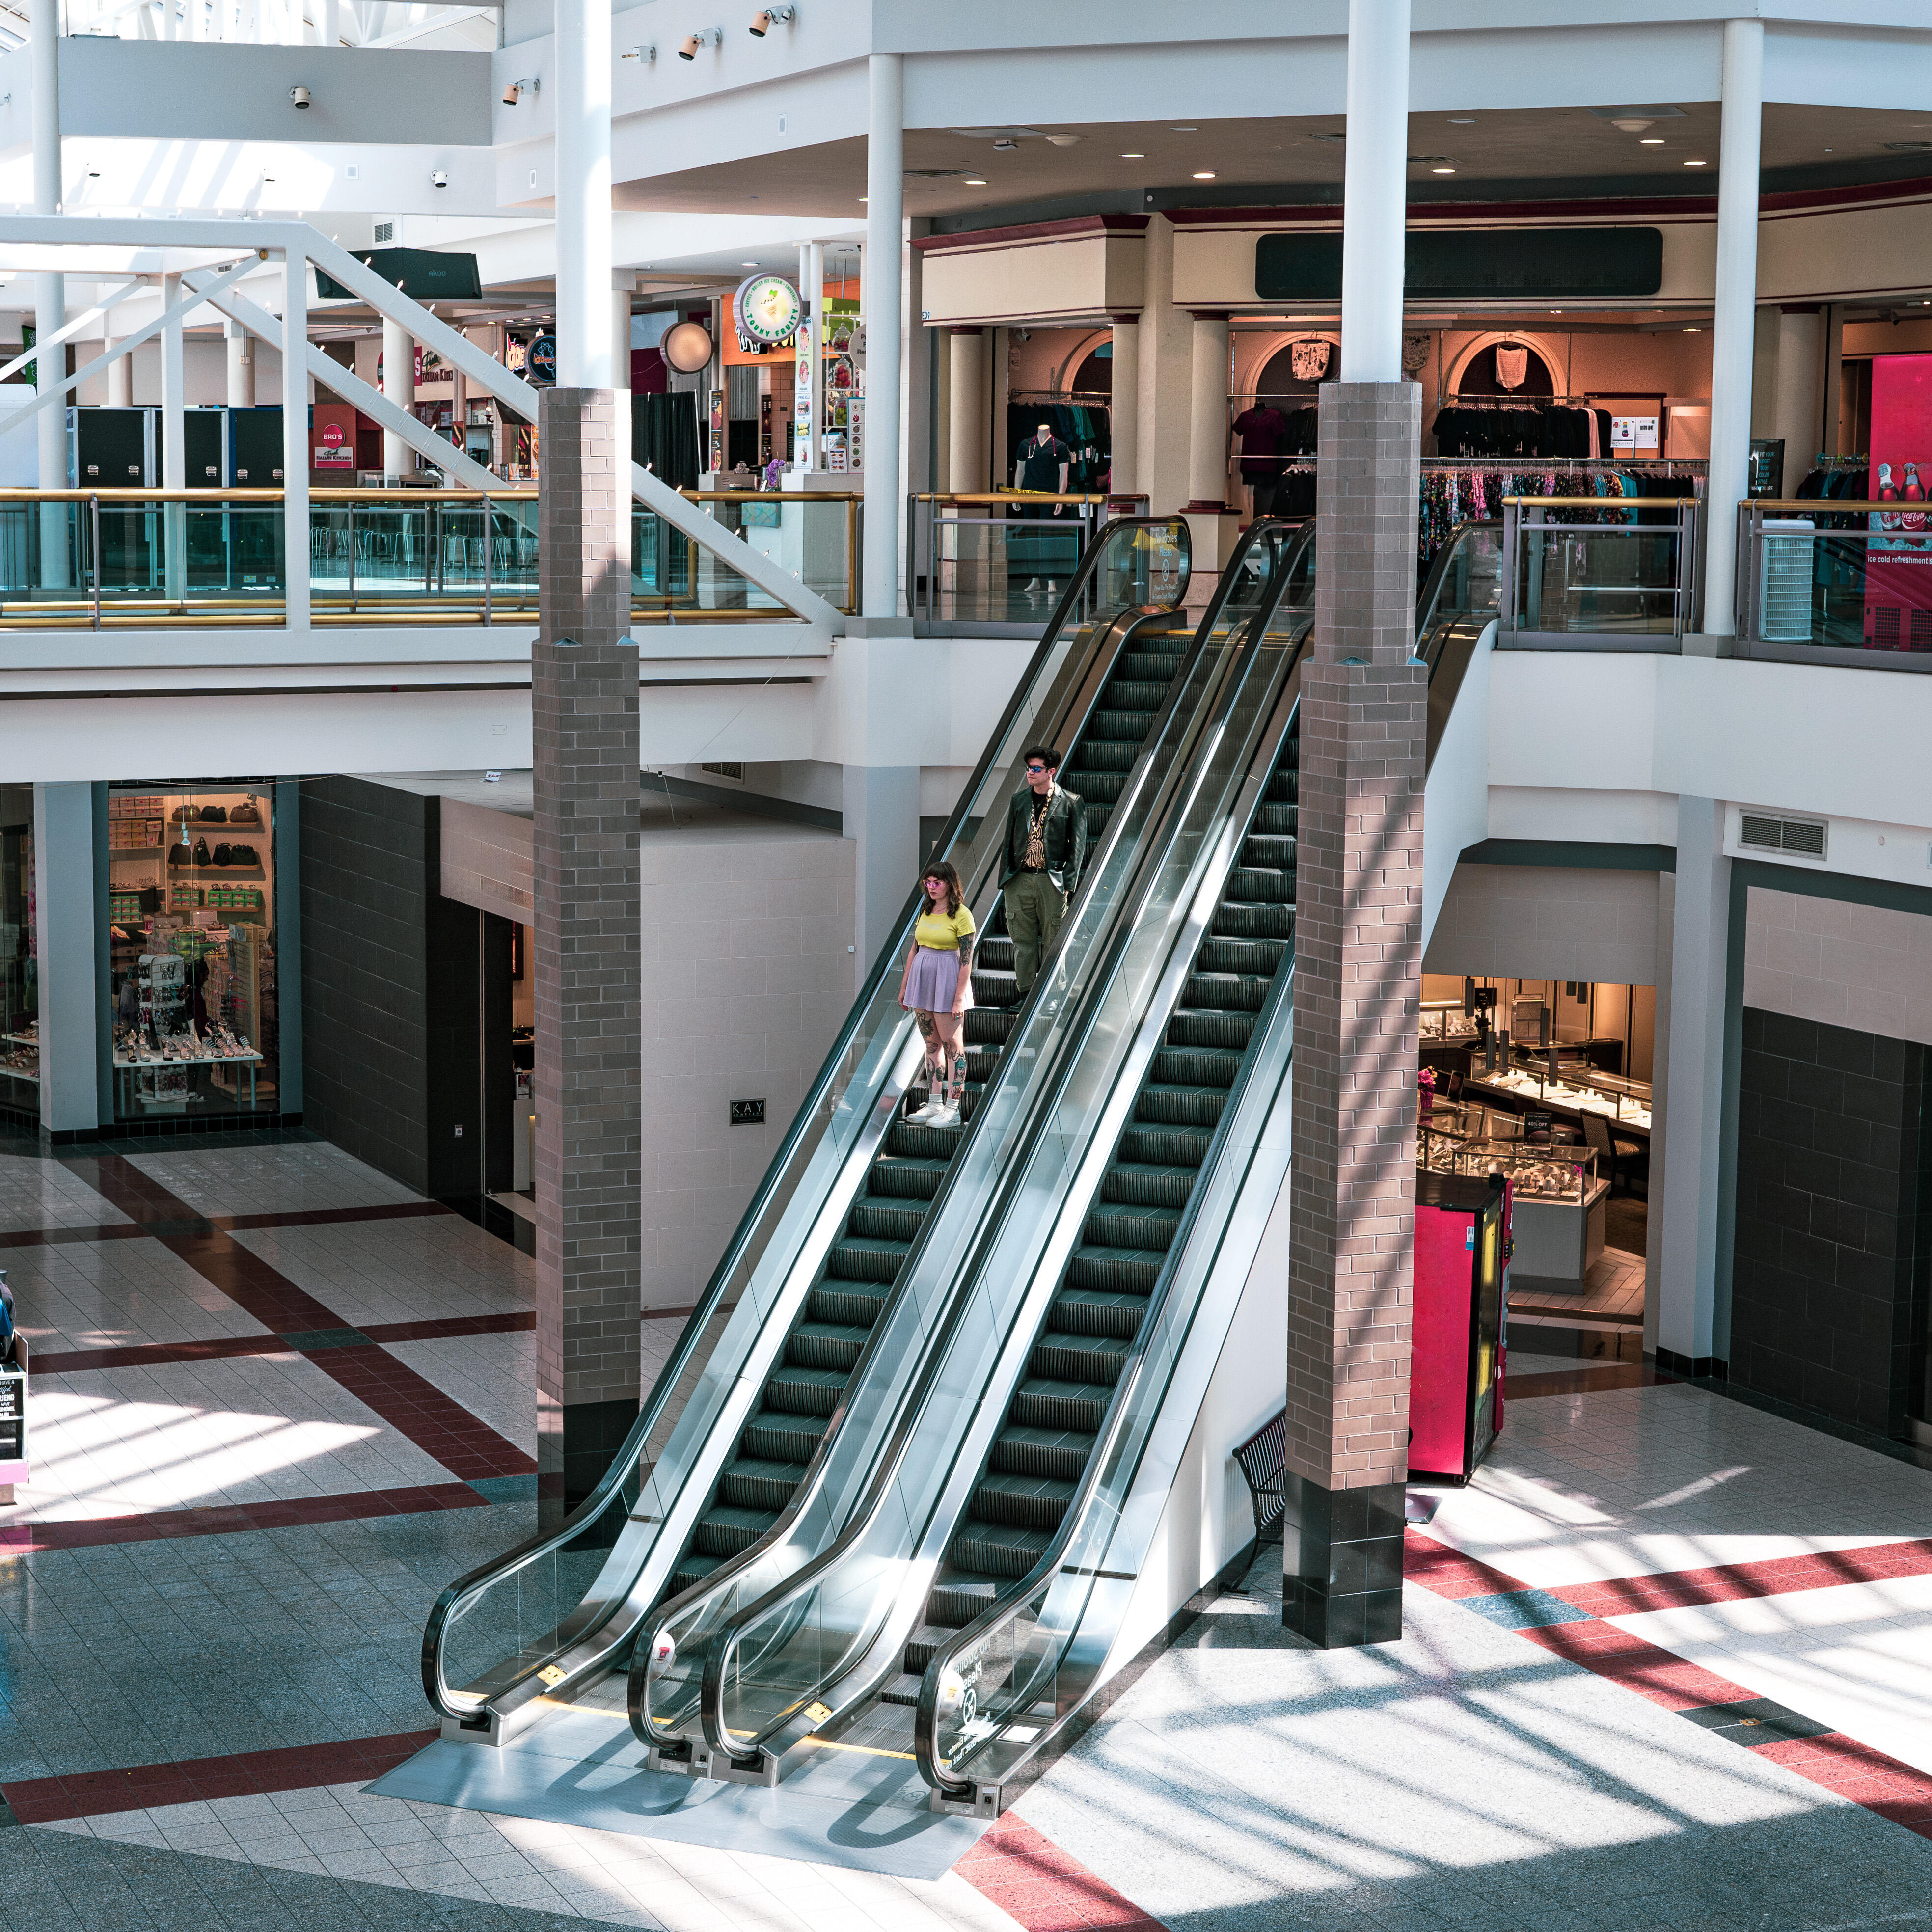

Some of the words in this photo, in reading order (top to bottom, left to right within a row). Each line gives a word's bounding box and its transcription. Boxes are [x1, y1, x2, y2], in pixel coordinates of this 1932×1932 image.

[747, 313, 770, 337] TOUHY
[775, 308, 798, 337] FRUITY
[1155, 532, 1161, 543] No
[1162, 531, 1177, 544] Strollers
[733, 1102, 762, 1113] KAY
